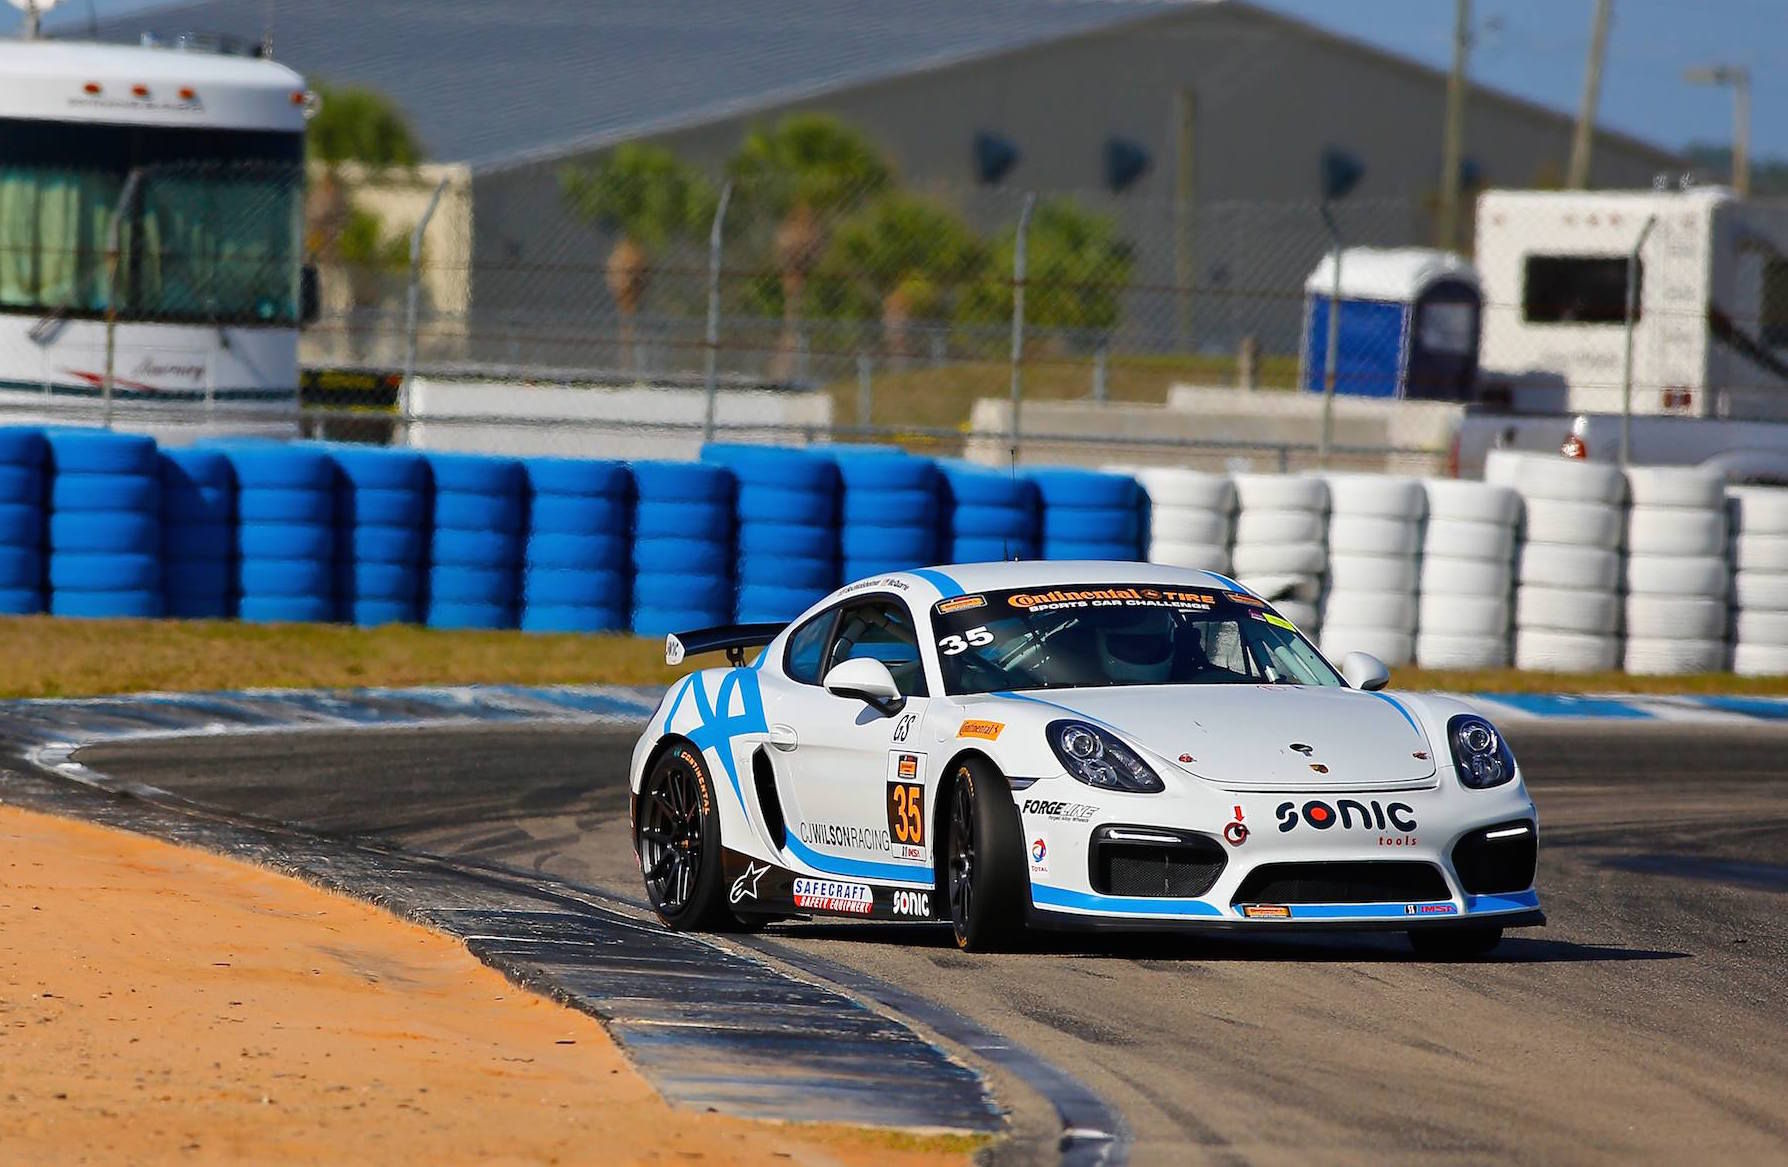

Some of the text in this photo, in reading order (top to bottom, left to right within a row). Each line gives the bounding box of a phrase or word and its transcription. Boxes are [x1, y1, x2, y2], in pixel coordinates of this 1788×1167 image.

[1007, 588, 1142, 608] Continental
[1163, 591, 1216, 604] TIRE
[1029, 599, 1210, 612] SPORTS CAR CHALLENGE
[938, 625, 995, 656] 35
[893, 714, 916, 742] GS
[893, 784, 922, 843] 35
[1379, 835, 1418, 847] tools
[795, 880, 865, 900] SAFECRAFT
[800, 896, 870, 914] SAFETY EQUIPMENT
